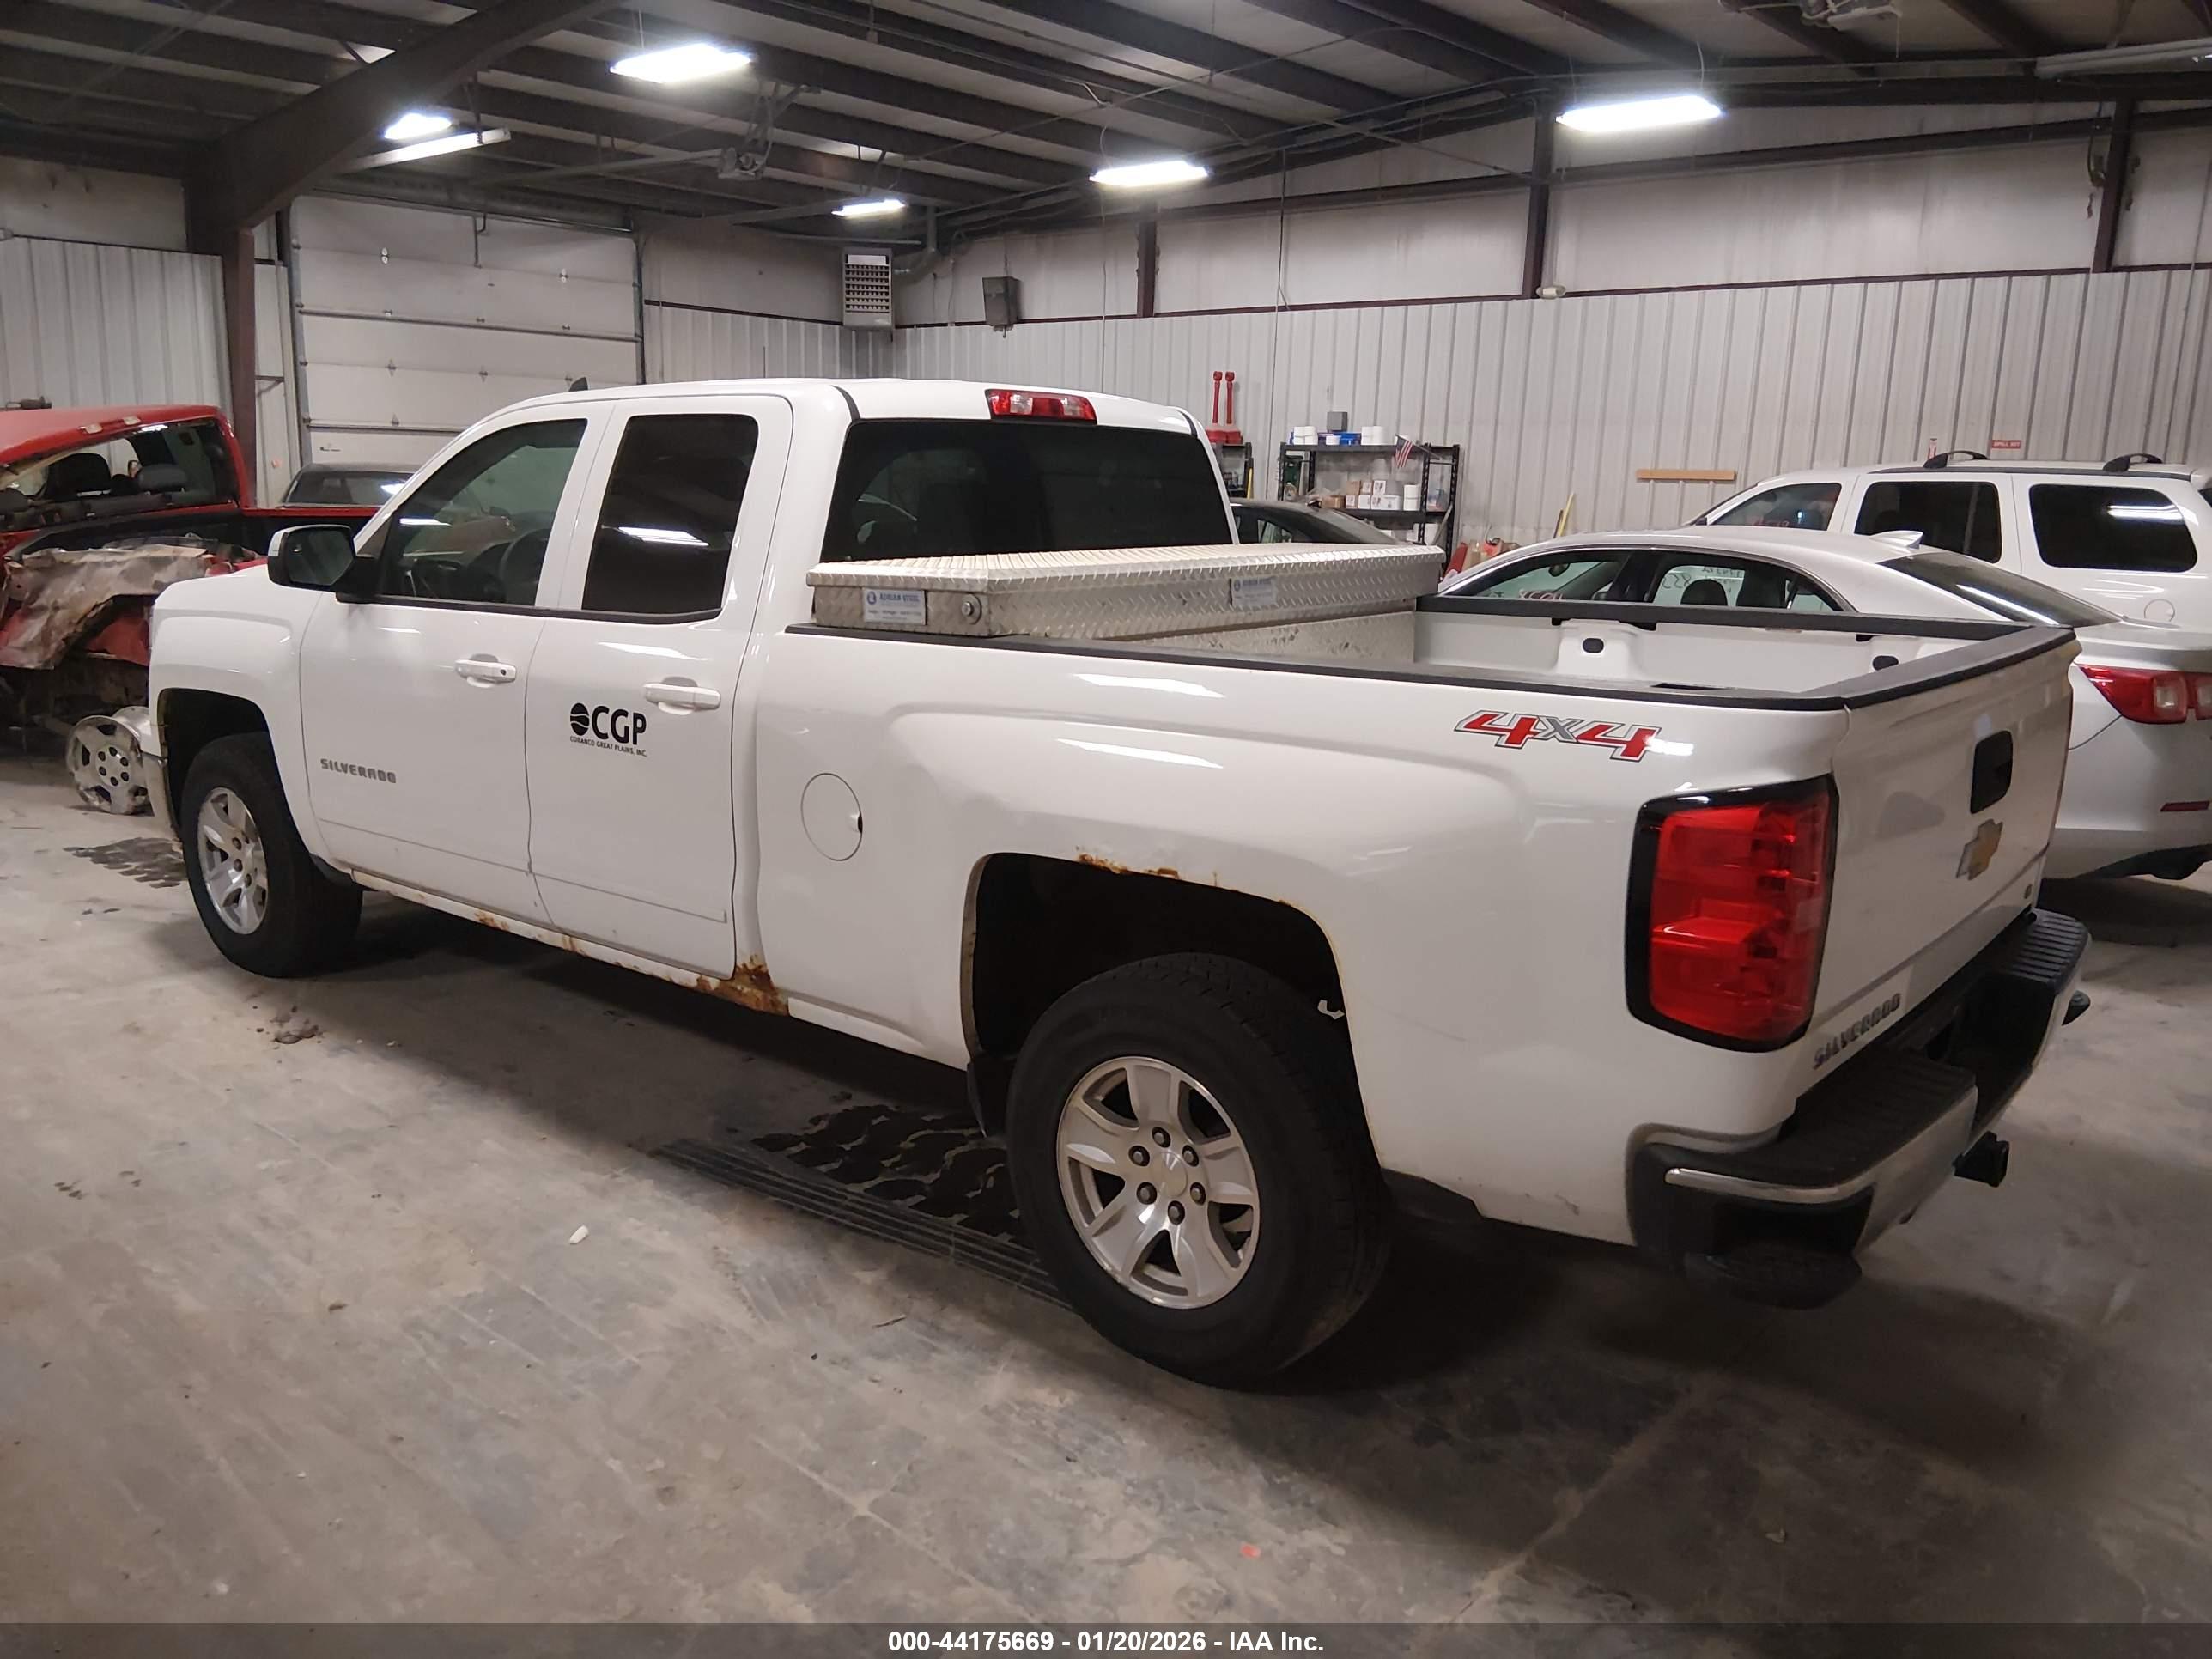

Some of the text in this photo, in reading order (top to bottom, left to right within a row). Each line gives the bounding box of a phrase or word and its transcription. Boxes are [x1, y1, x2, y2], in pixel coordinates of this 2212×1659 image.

[592, 705, 647, 745] CGP
[596, 740, 613, 750] GREAT
[320, 758, 397, 784] SILVERADO
[1813, 993, 1901, 1071] SILVERADO
